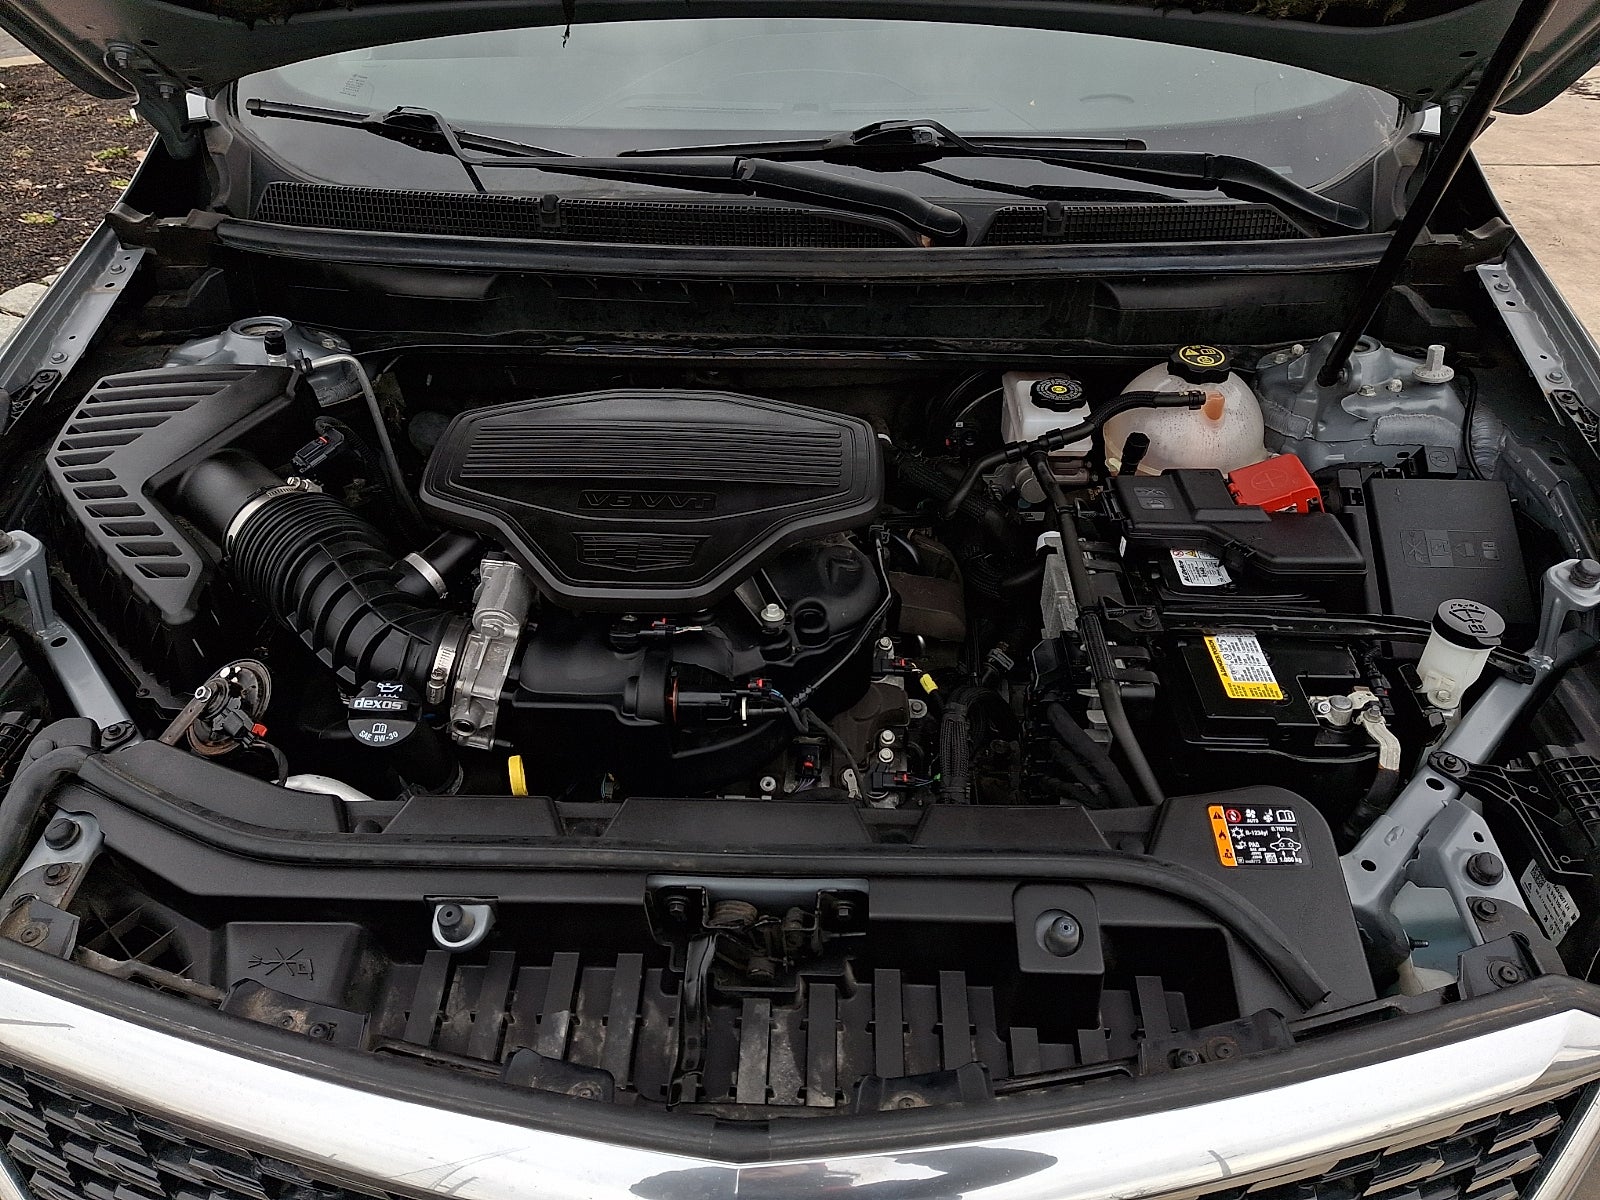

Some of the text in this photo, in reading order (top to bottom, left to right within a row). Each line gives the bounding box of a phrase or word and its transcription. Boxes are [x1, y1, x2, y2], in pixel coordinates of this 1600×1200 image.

[584, 493, 712, 508] V6 VVT
[353, 697, 403, 710] dexos
[359, 730, 398, 742] SAE 5W-30
